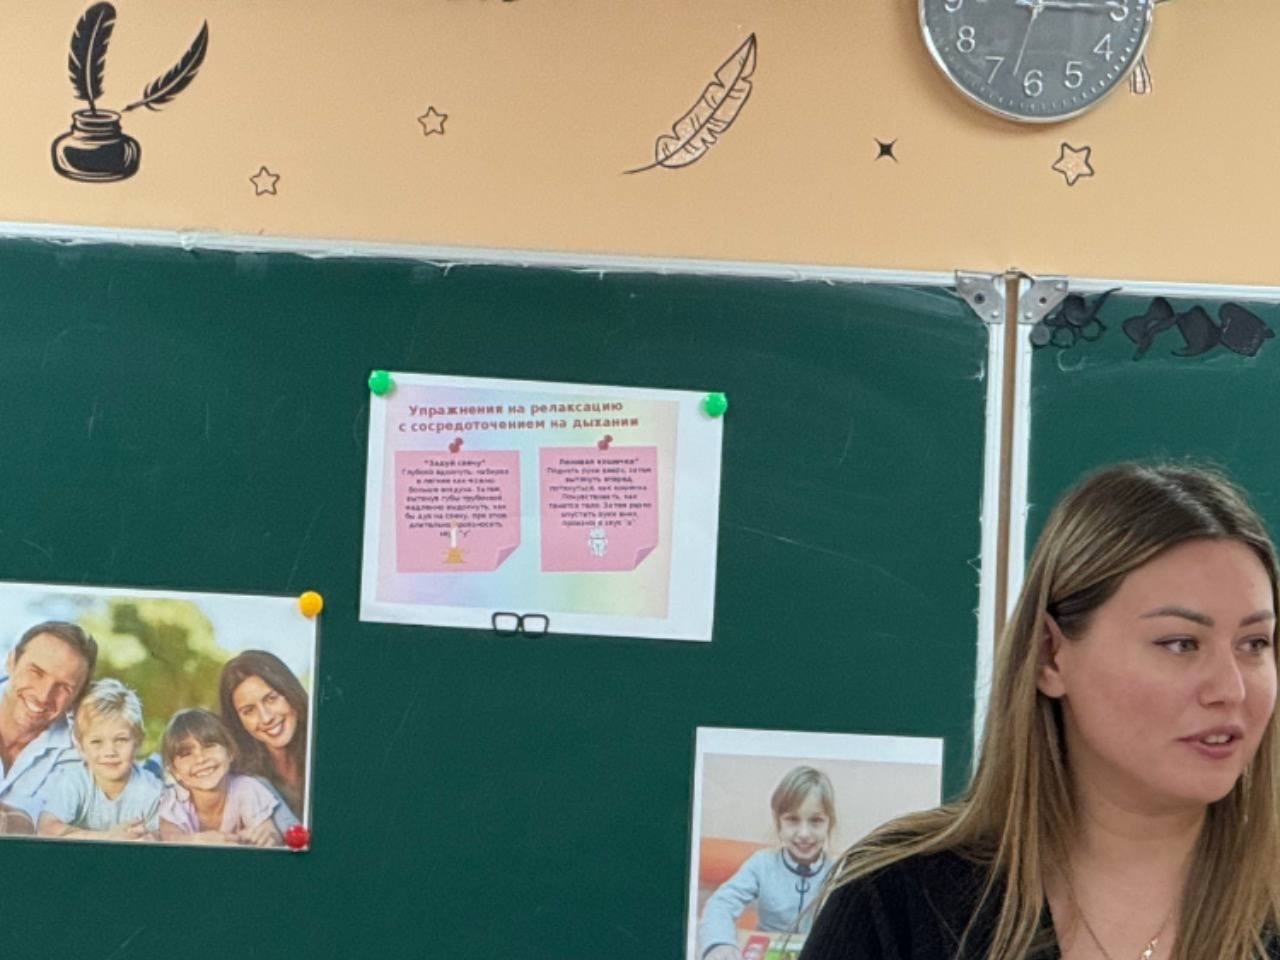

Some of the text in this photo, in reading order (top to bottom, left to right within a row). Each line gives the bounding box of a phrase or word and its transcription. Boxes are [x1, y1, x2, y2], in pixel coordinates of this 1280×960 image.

[956, 25, 976, 53] 8
[1093, 33, 1114, 61] 4
[984, 56, 1004, 84] 7
[1023, 69, 1043, 97] 6
[1064, 61, 1083, 88] 5
[408, 401, 624, 418] Упражнения на релаксацию
[399, 417, 639, 434] с сосредоточением на дыхании
